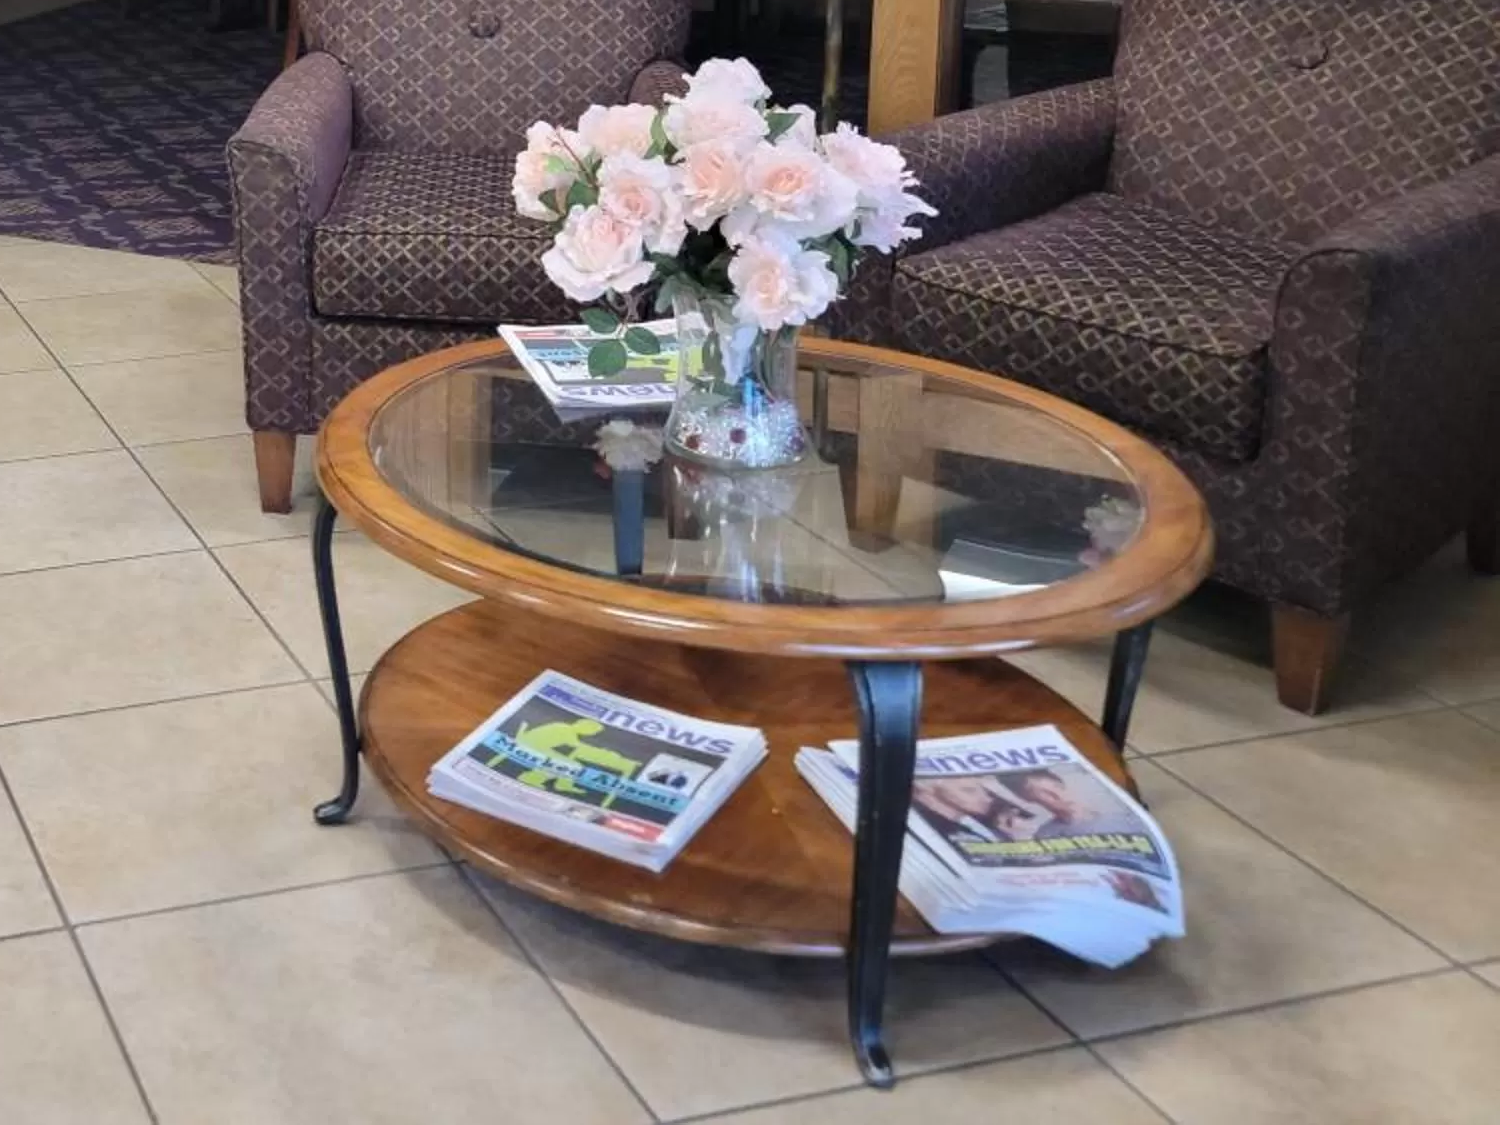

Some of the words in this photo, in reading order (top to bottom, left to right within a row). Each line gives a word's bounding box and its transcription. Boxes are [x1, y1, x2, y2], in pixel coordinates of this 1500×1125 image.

[606, 710, 735, 754] news
[493, 735, 587, 778] Marked
[592, 772, 678, 807] Absent
[934, 744, 1070, 773] news
